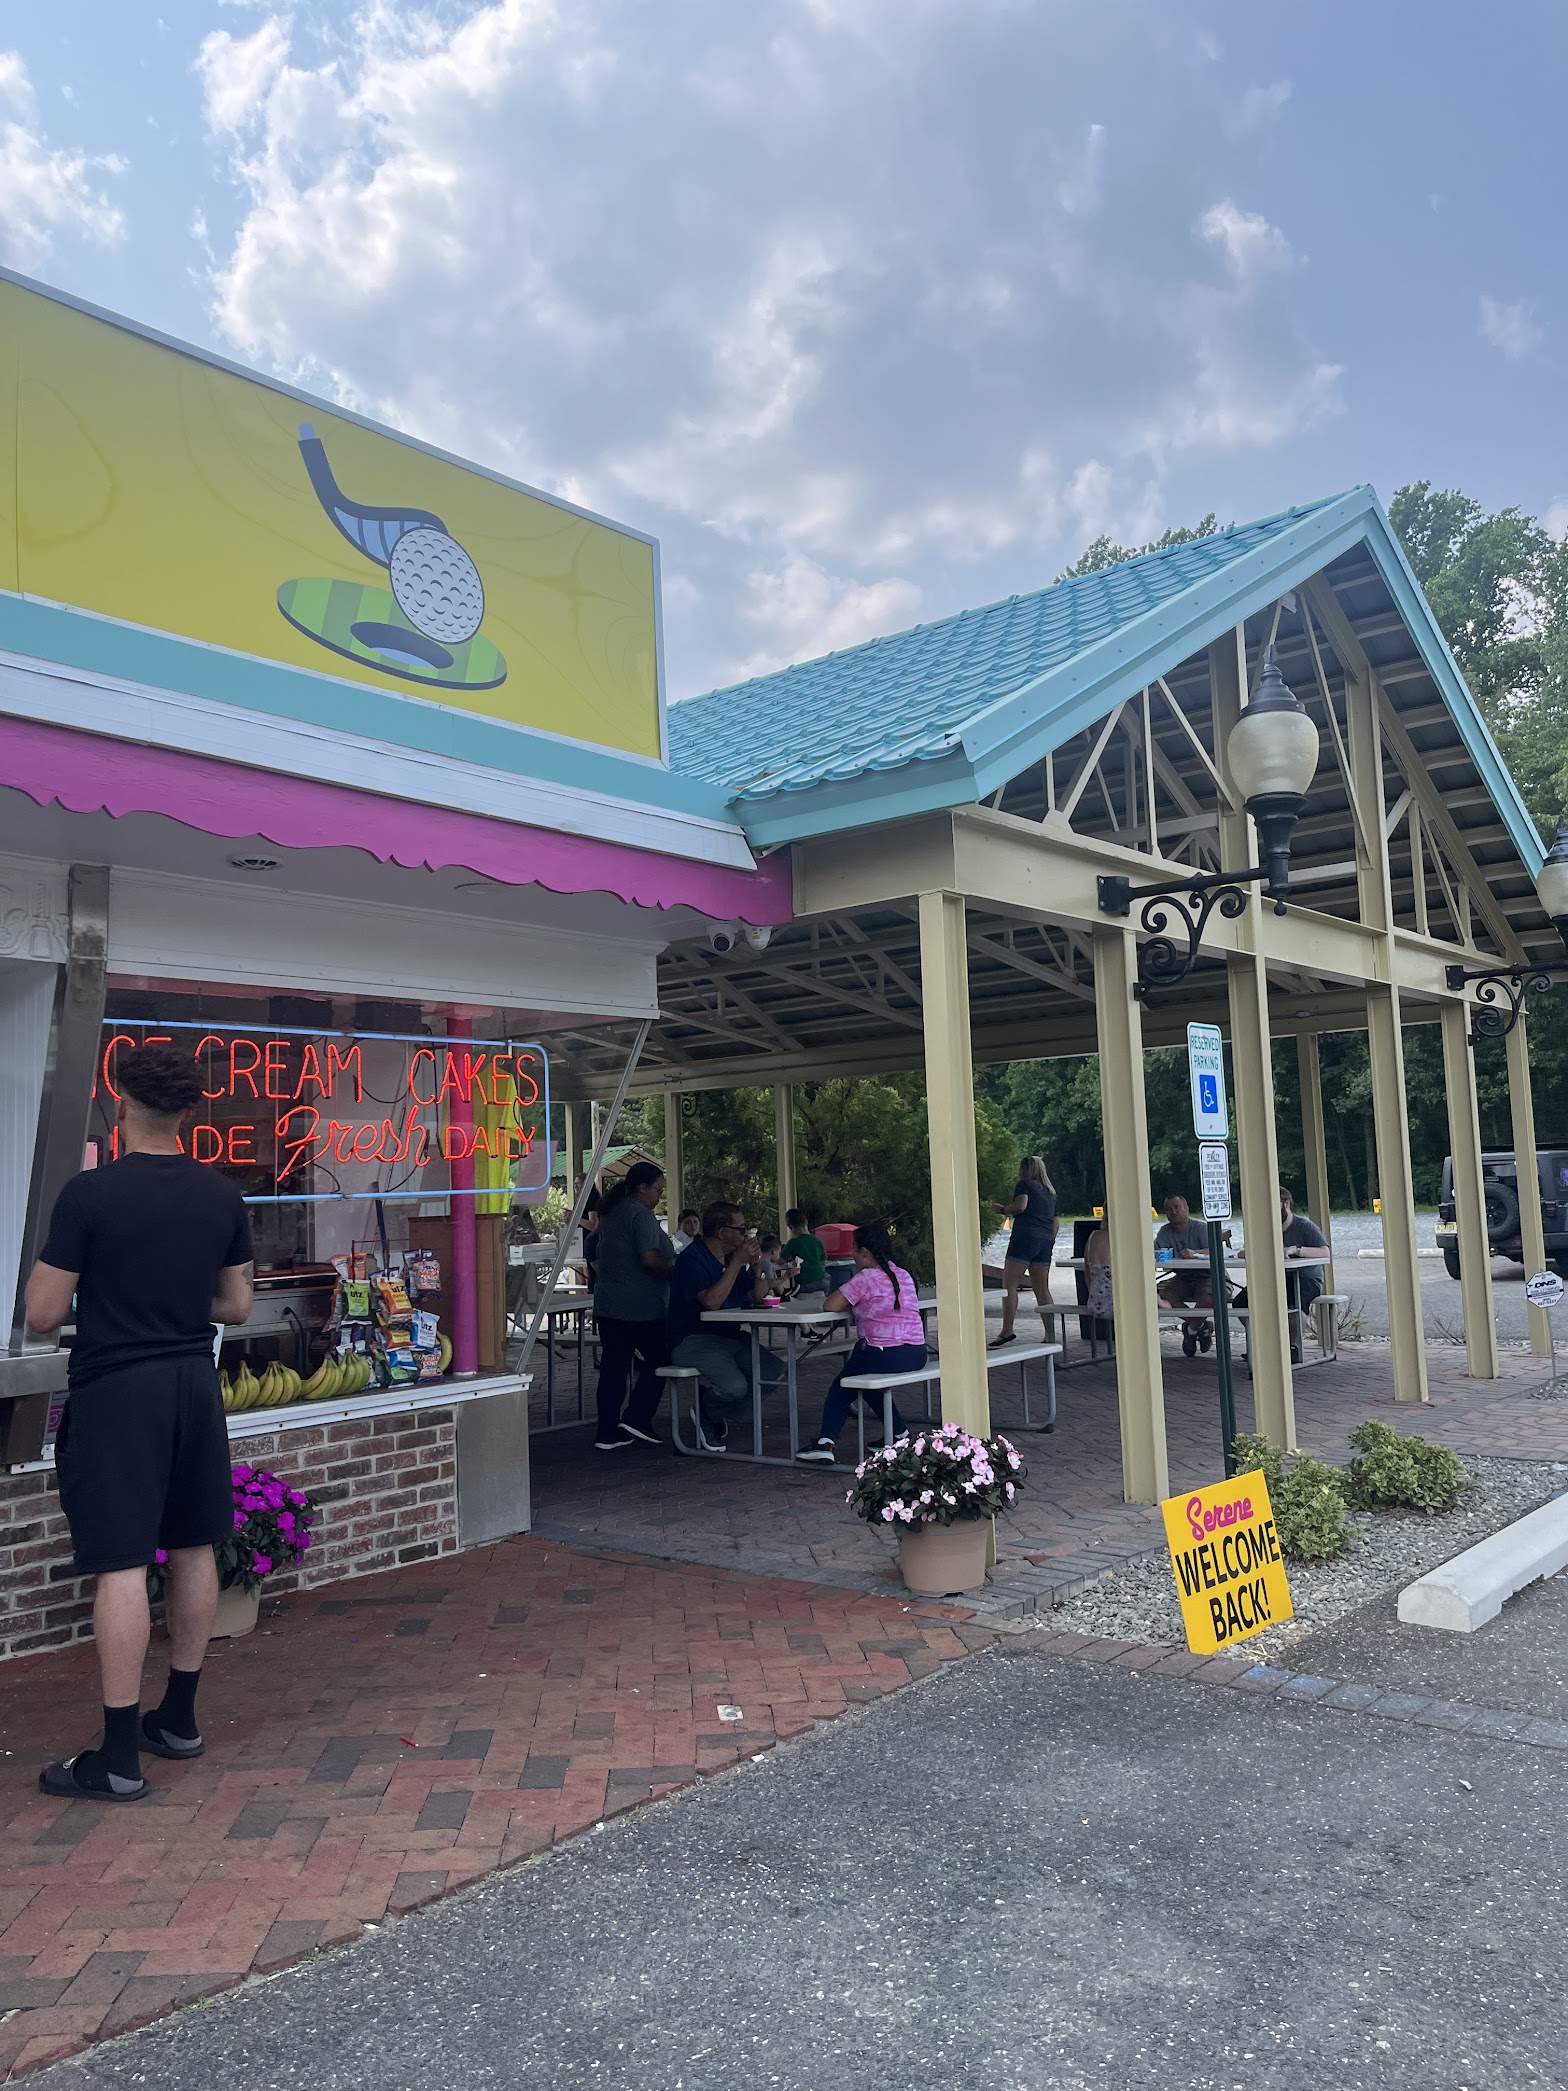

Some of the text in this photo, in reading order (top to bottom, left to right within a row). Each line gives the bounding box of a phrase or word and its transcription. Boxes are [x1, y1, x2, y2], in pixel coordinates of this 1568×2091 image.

[1190, 1035, 1219, 1051] RESERVED
[194, 1035, 362, 1103] CREAM
[409, 1049, 539, 1107] CAKES
[1193, 1054, 1219, 1070] PARKING
[274, 1105, 431, 1182] Fresh
[443, 1126, 536, 1160] DAILY
[350, 1290, 363, 1299] utz
[391, 1284, 406, 1293] utz
[1534, 1279, 1557, 1288] DNS
[1186, 1496, 1254, 1542] Serene
[1174, 1519, 1281, 1598] WELCOME
[1208, 1577, 1272, 1643] BACK!
